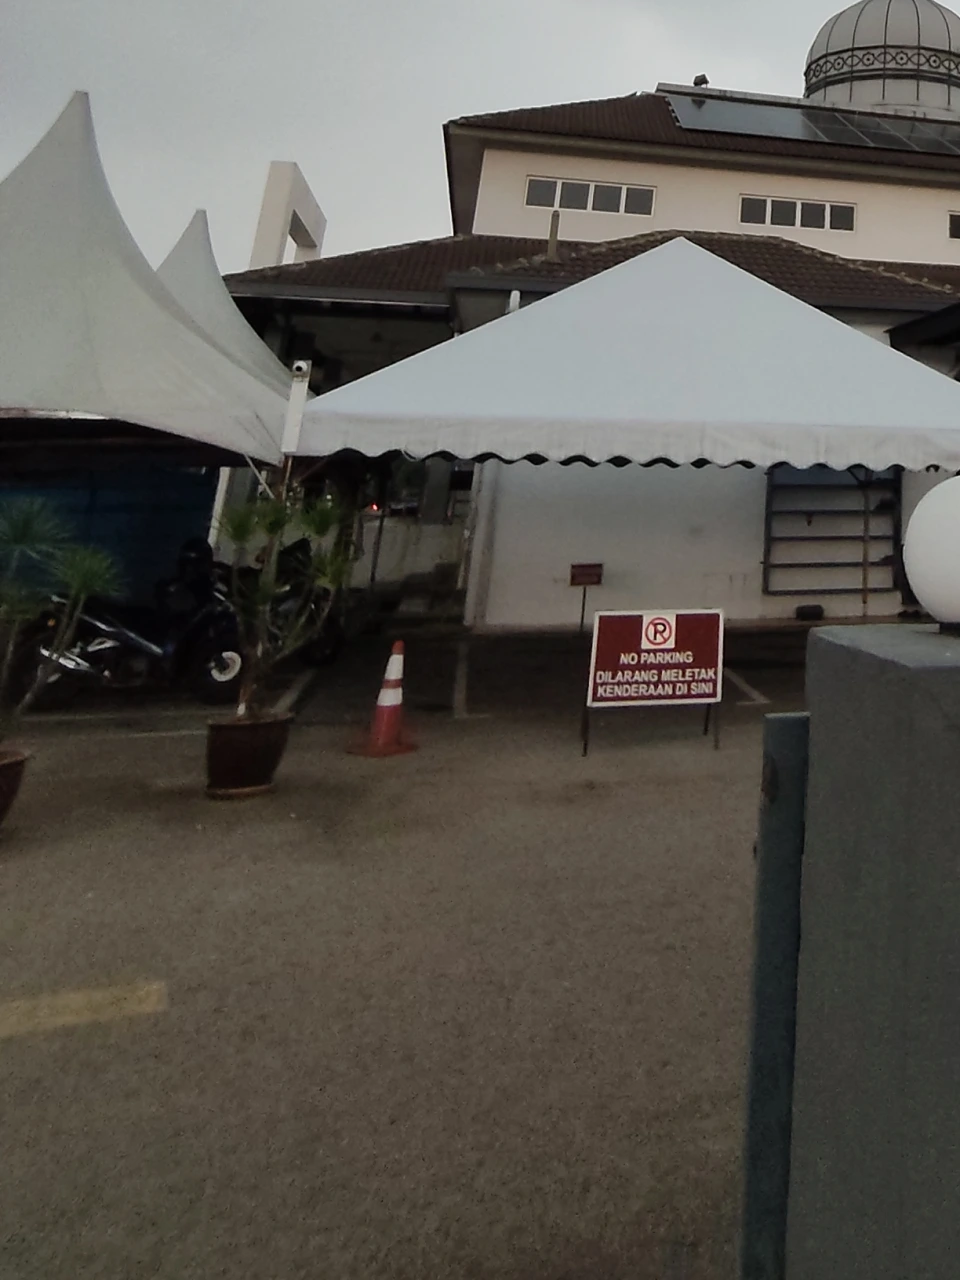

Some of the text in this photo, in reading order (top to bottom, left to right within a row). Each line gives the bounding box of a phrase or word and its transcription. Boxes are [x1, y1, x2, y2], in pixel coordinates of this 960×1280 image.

[620, 651, 693, 665] NO PARKING
[596, 668, 716, 683] DILARANG MELETAK
[597, 682, 713, 697] KENDERAAN DI SINI
